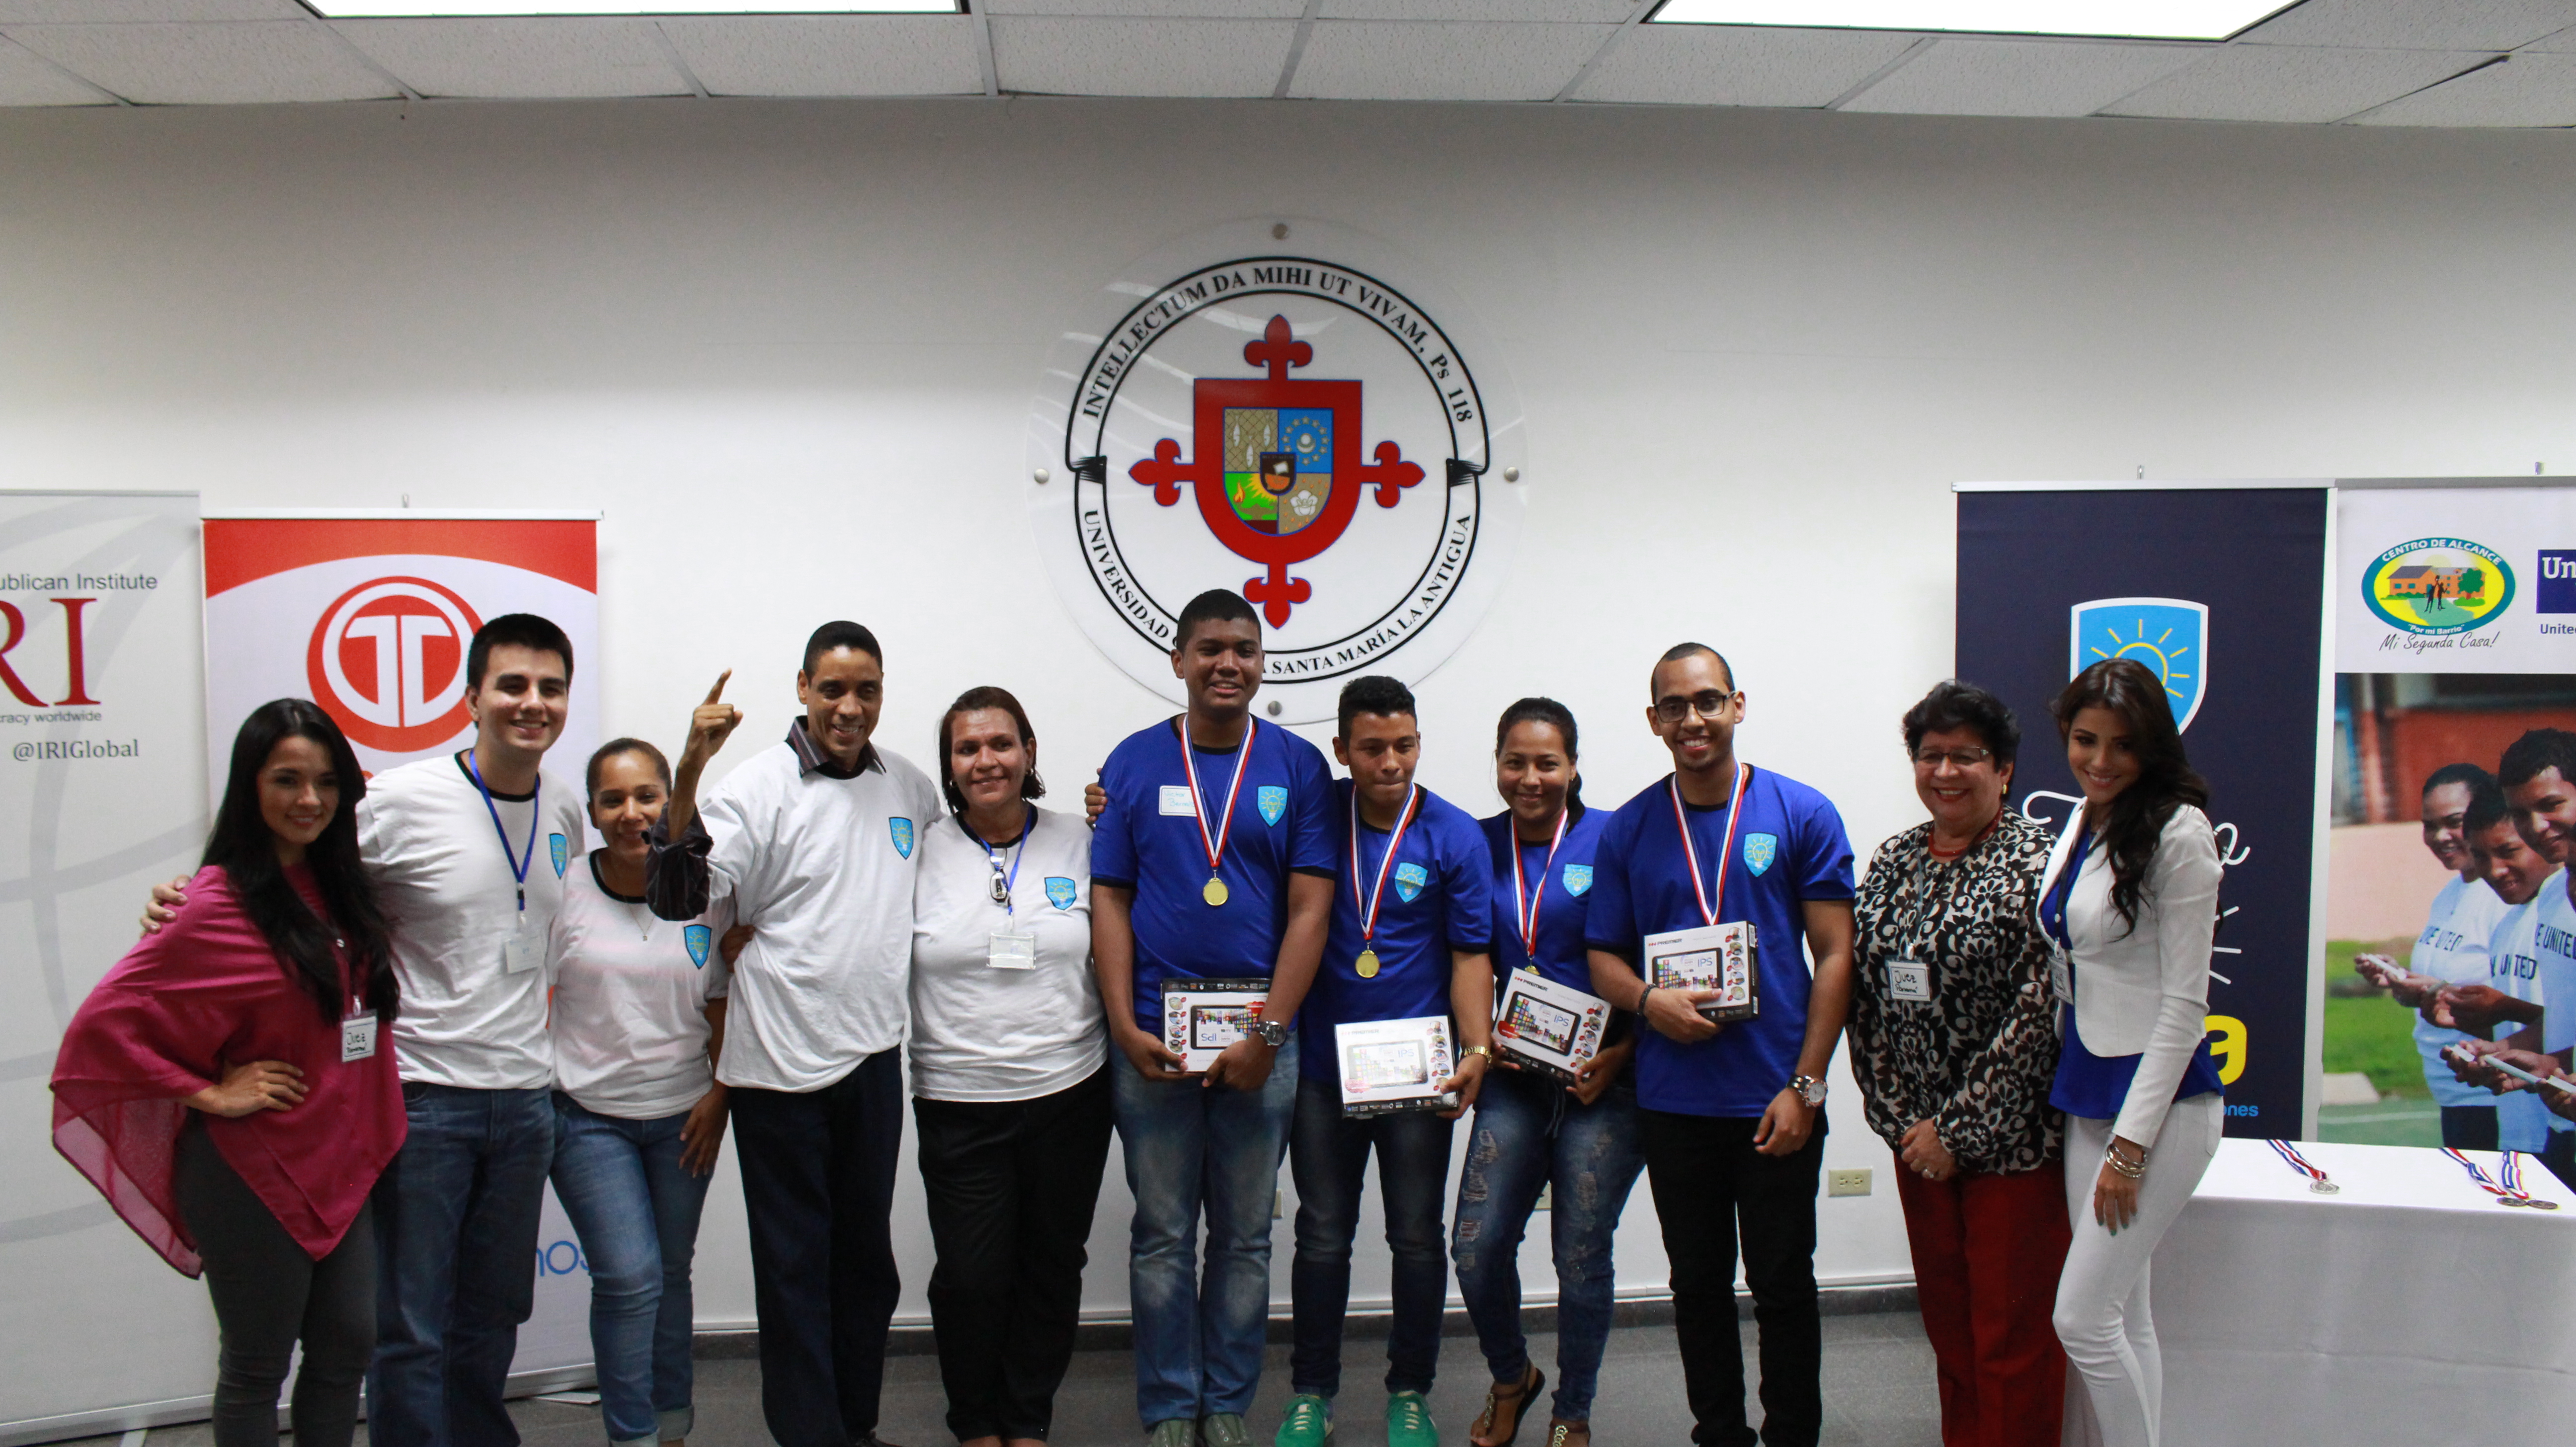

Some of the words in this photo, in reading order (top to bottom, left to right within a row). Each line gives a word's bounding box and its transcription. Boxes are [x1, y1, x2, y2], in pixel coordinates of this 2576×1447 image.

[1083, 281, 1208, 419] INTELLECTUM
[1212, 271, 1246, 293] DA
[1253, 267, 1312, 286] MIHI
[1320, 272, 1352, 295] UT
[1359, 285, 1428, 353] VIVAM,
[1430, 353, 1450, 379] Ps
[1448, 388, 1473, 422] 118
[2382, 540, 2428, 563] CENTRO
[2430, 539, 2446, 548] DE
[2448, 540, 2503, 565] ALCANCE
[77, 573, 158, 590] Institute
[1084, 509, 1169, 638] UNIVERSIDAD
[1272, 656, 1334, 674] SANTA
[1337, 628, 1400, 664] MARÍA
[1396, 608, 1423, 630] LA
[1421, 515, 1471, 609] ANTIGUA
[2540, 624, 2576, 634] Unite
[2379, 633, 2398, 651] Mi
[2404, 632, 2453, 655] Segunda
[2460, 631, 2500, 648] Casa!
[35, 711, 102, 723] worldwide
[13, 739, 139, 761] @IRIGlobal
[1697, 958, 1712, 967] IPS
[1523, 979, 1548, 991] PREMIER
[1554, 1015, 1569, 1027] IPS
[1398, 1049, 1414, 1057] IPS
